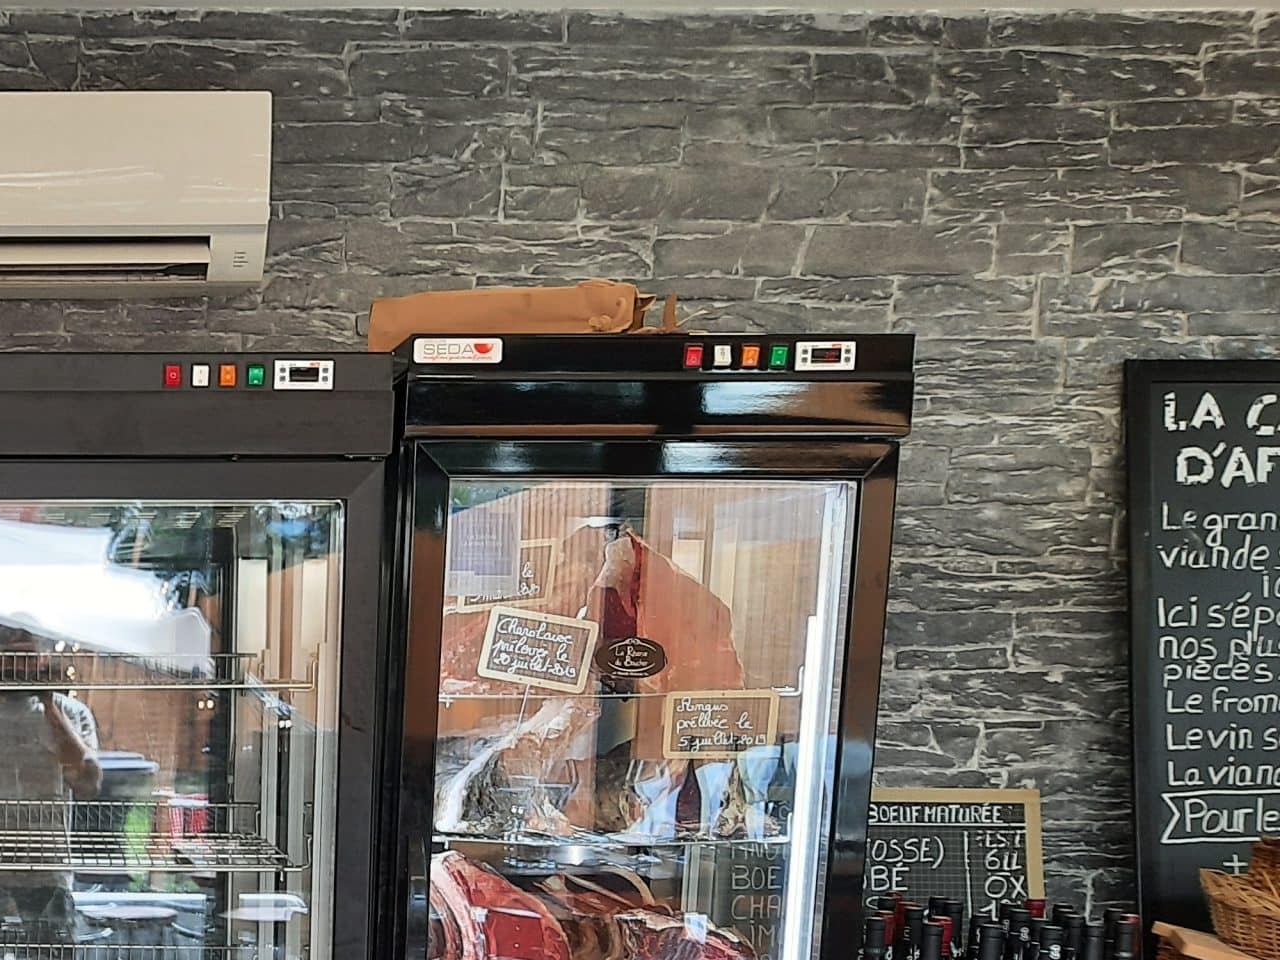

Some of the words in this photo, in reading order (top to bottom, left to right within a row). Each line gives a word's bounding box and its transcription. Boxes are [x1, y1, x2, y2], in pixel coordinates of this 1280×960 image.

[424, 343, 474, 355] SEDA
[1163, 390, 1226, 431] LA
[1176, 441, 1280, 488] D'AF
[1162, 501, 1198, 530] Le
[1202, 512, 1280, 547] gran
[1157, 533, 1270, 571] viande
[1158, 596, 1199, 628] Ici
[1159, 636, 1218, 661] nos
[1228, 630, 1280, 668] plu
[1167, 690, 1204, 713] Le
[1212, 686, 1280, 713] from
[1166, 723, 1203, 750] Le
[1207, 723, 1254, 750] vin
[1167, 760, 1205, 786] La
[1184, 798, 1254, 833] Pour
[732, 865, 783, 890] BOE
[731, 894, 782, 920] CHA
